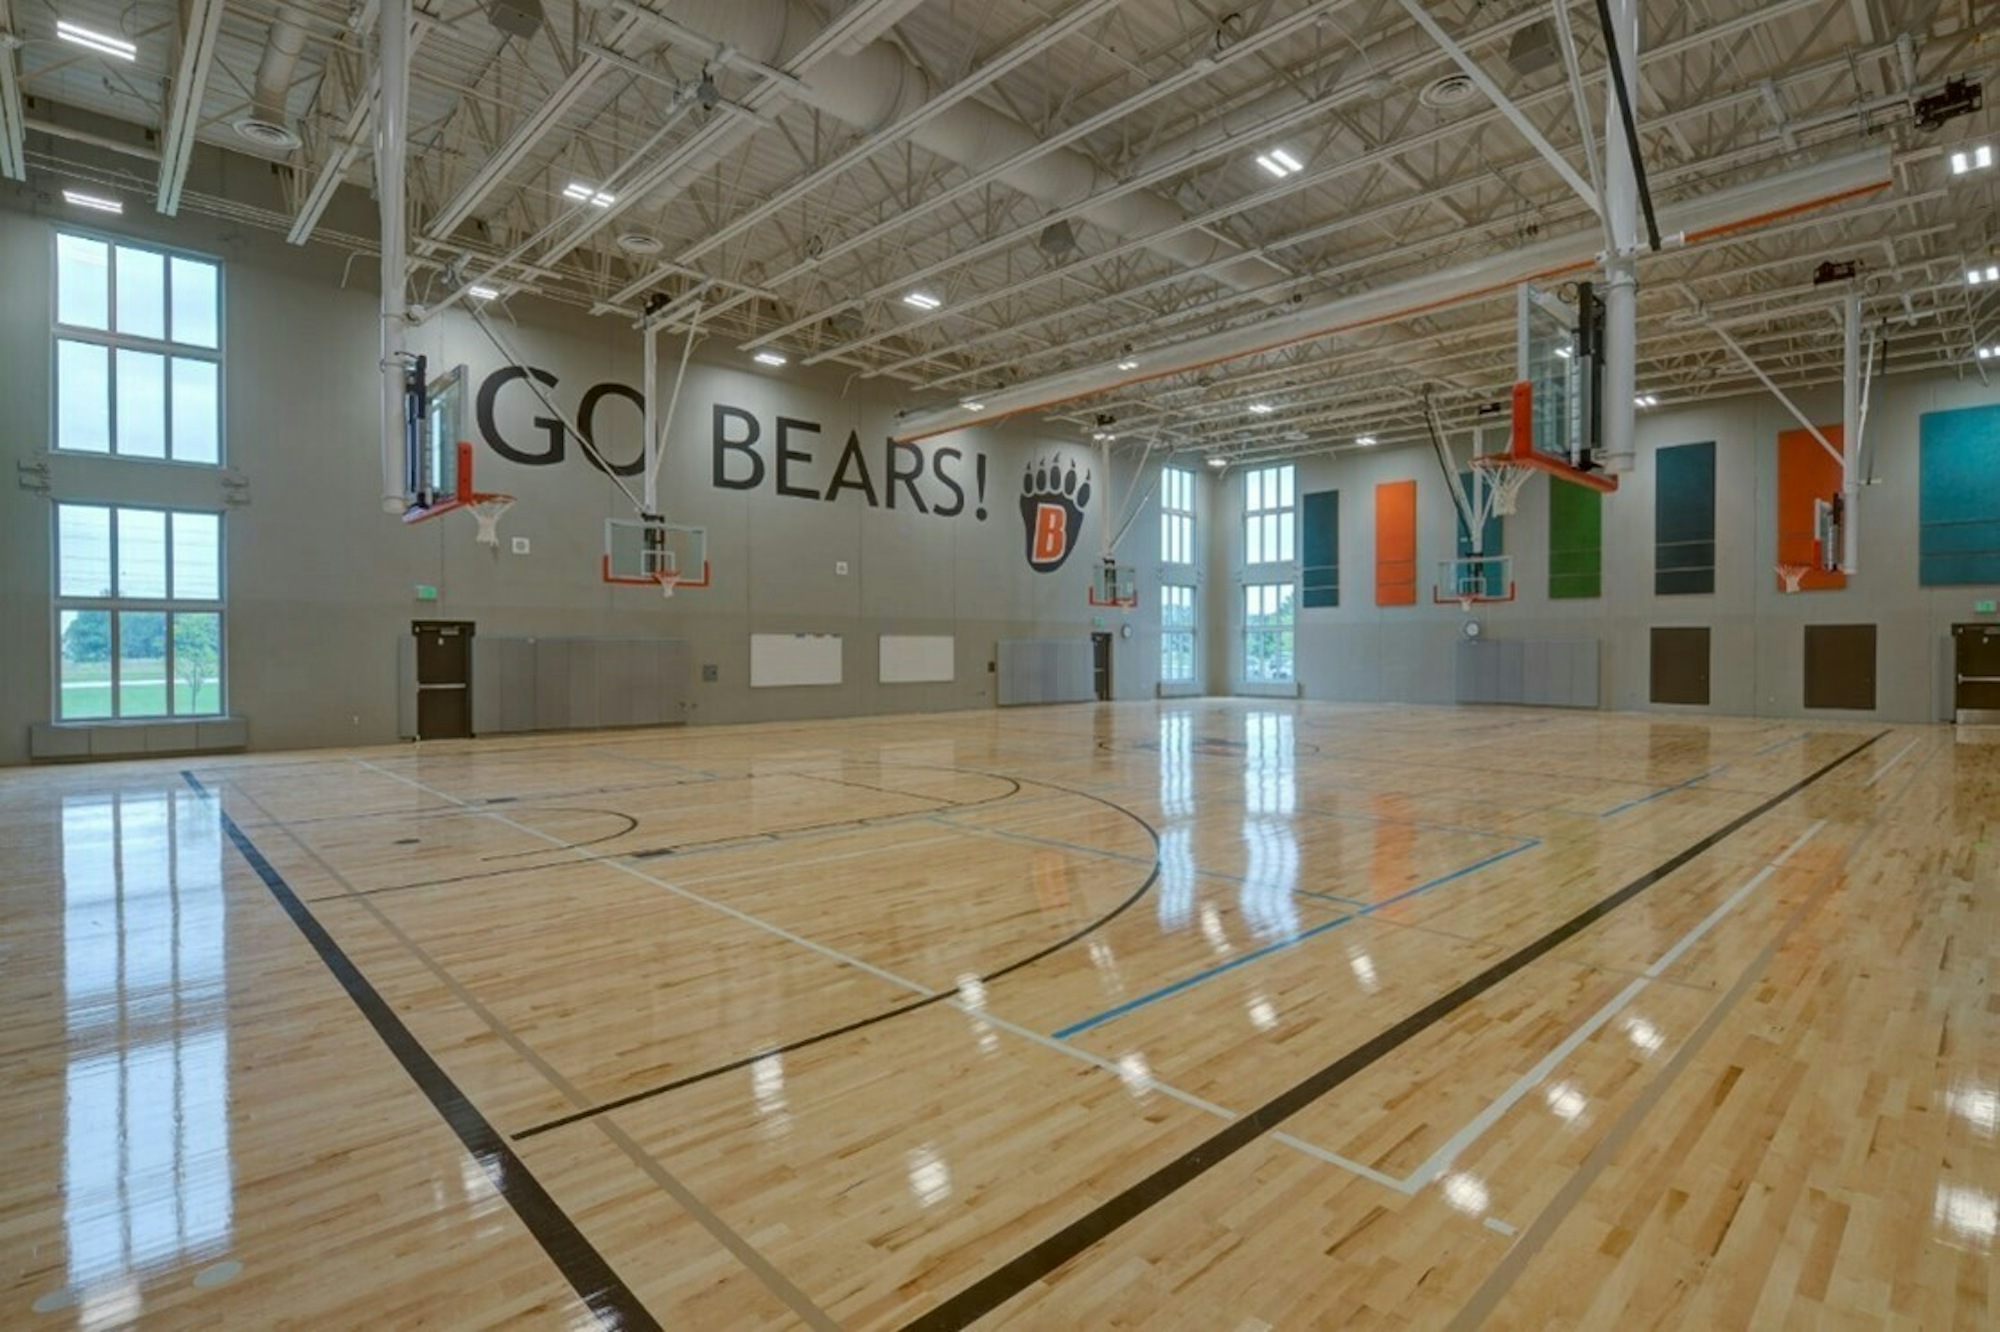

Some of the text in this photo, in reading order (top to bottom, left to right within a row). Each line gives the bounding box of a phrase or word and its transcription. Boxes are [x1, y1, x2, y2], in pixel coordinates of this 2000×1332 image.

[476, 366, 988, 521] GO BEARS!
[1032, 503, 1067, 563] B
